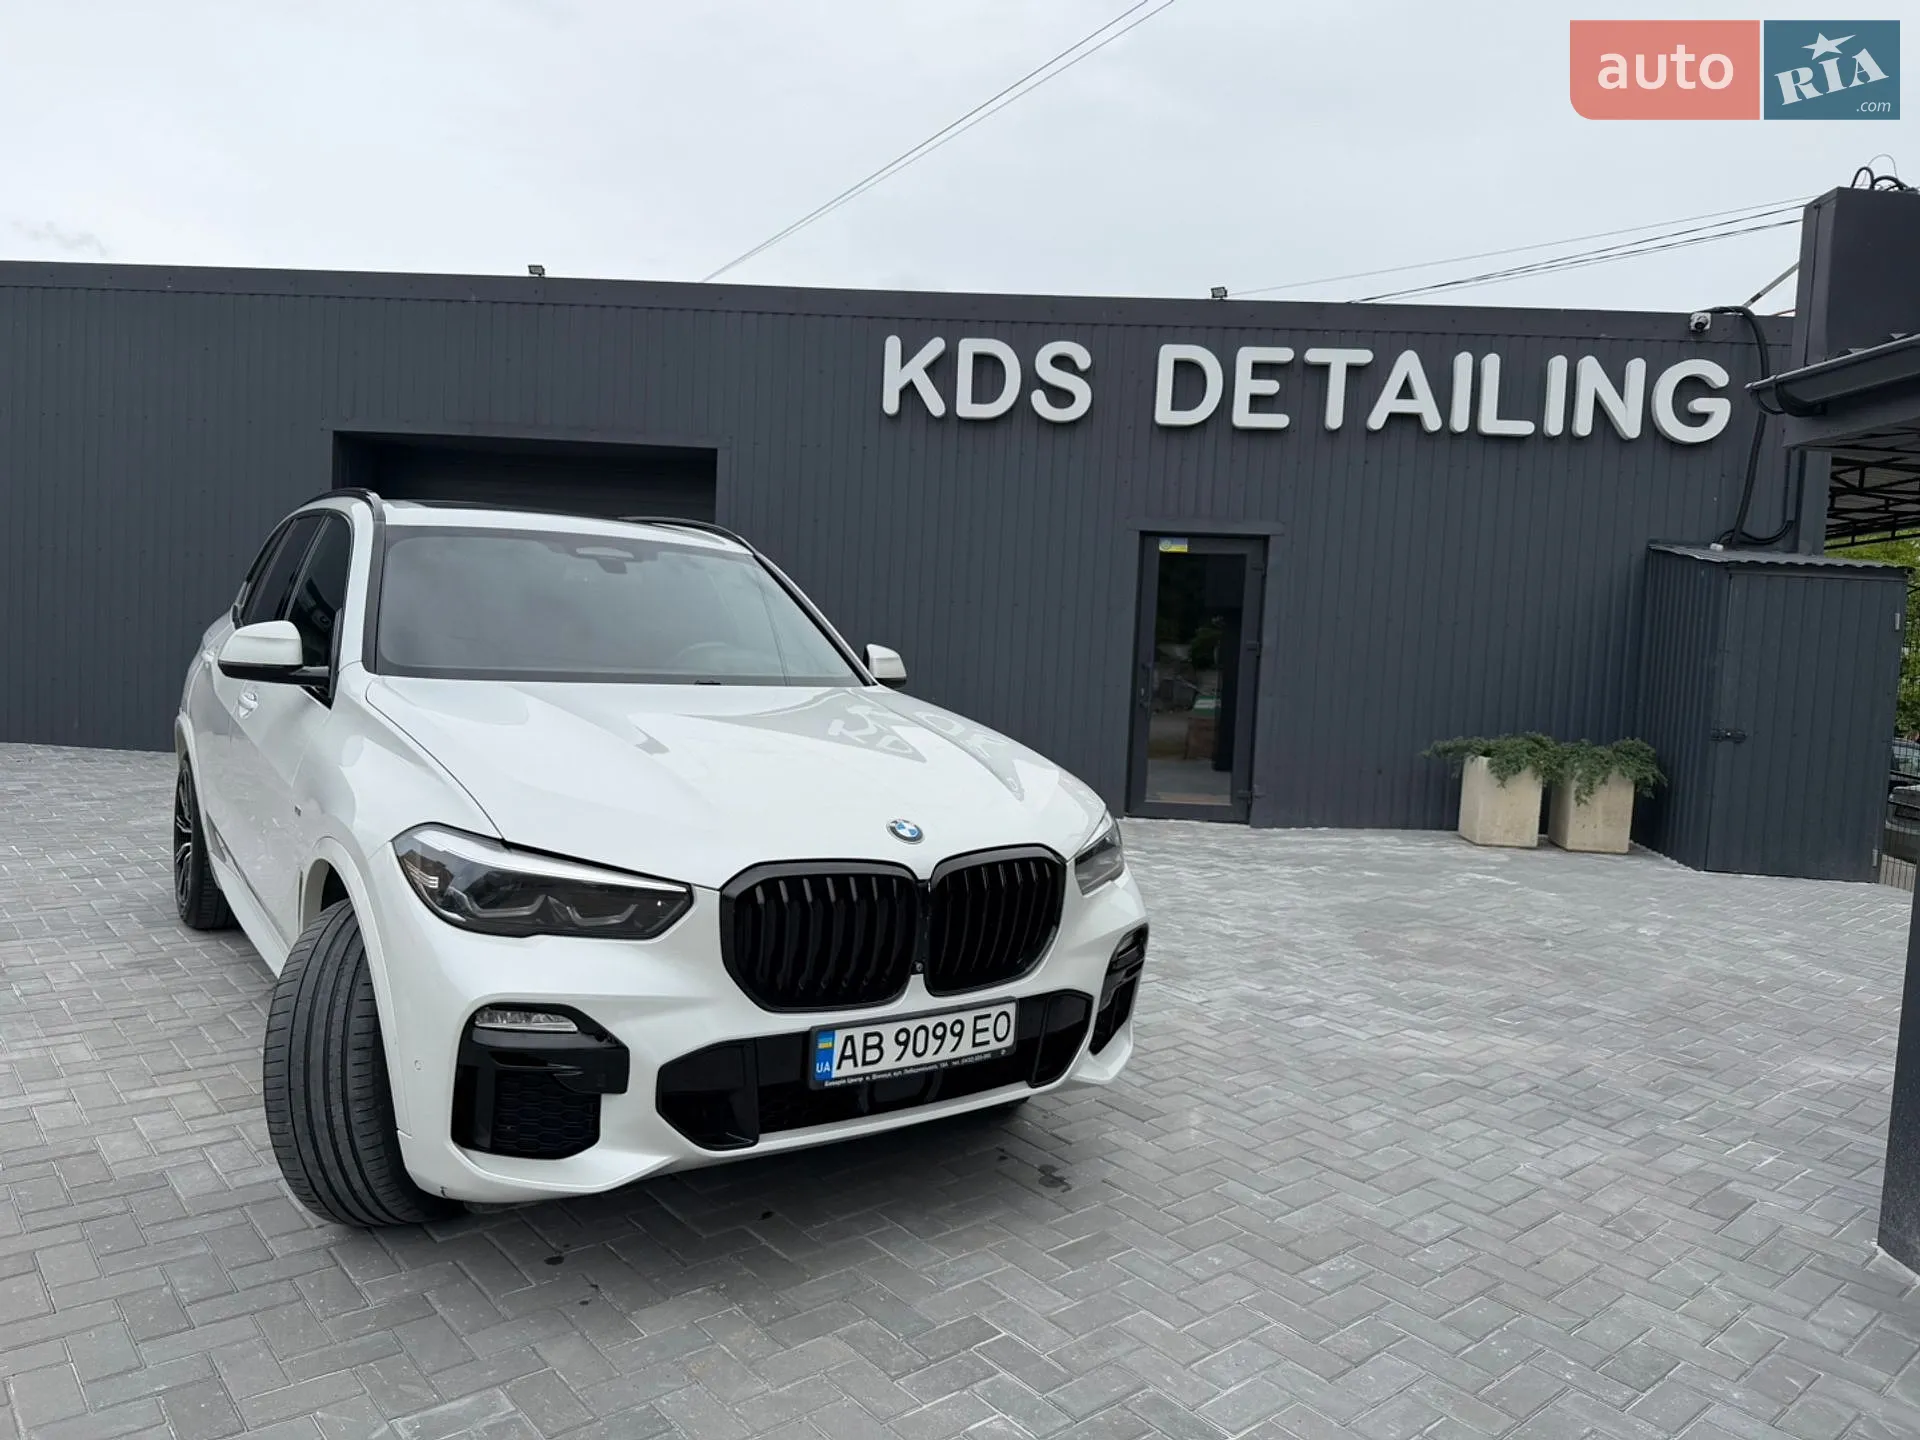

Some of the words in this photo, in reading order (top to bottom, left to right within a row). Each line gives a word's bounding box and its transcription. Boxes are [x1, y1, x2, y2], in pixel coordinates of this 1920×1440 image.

[881, 334, 1093, 424] KDS
[1153, 342, 1732, 445] DETAILING
[815, 1059, 832, 1074] UA
[837, 1031, 884, 1070] AB
[893, 1018, 965, 1062] 9099
[972, 1011, 1011, 1048] EO
